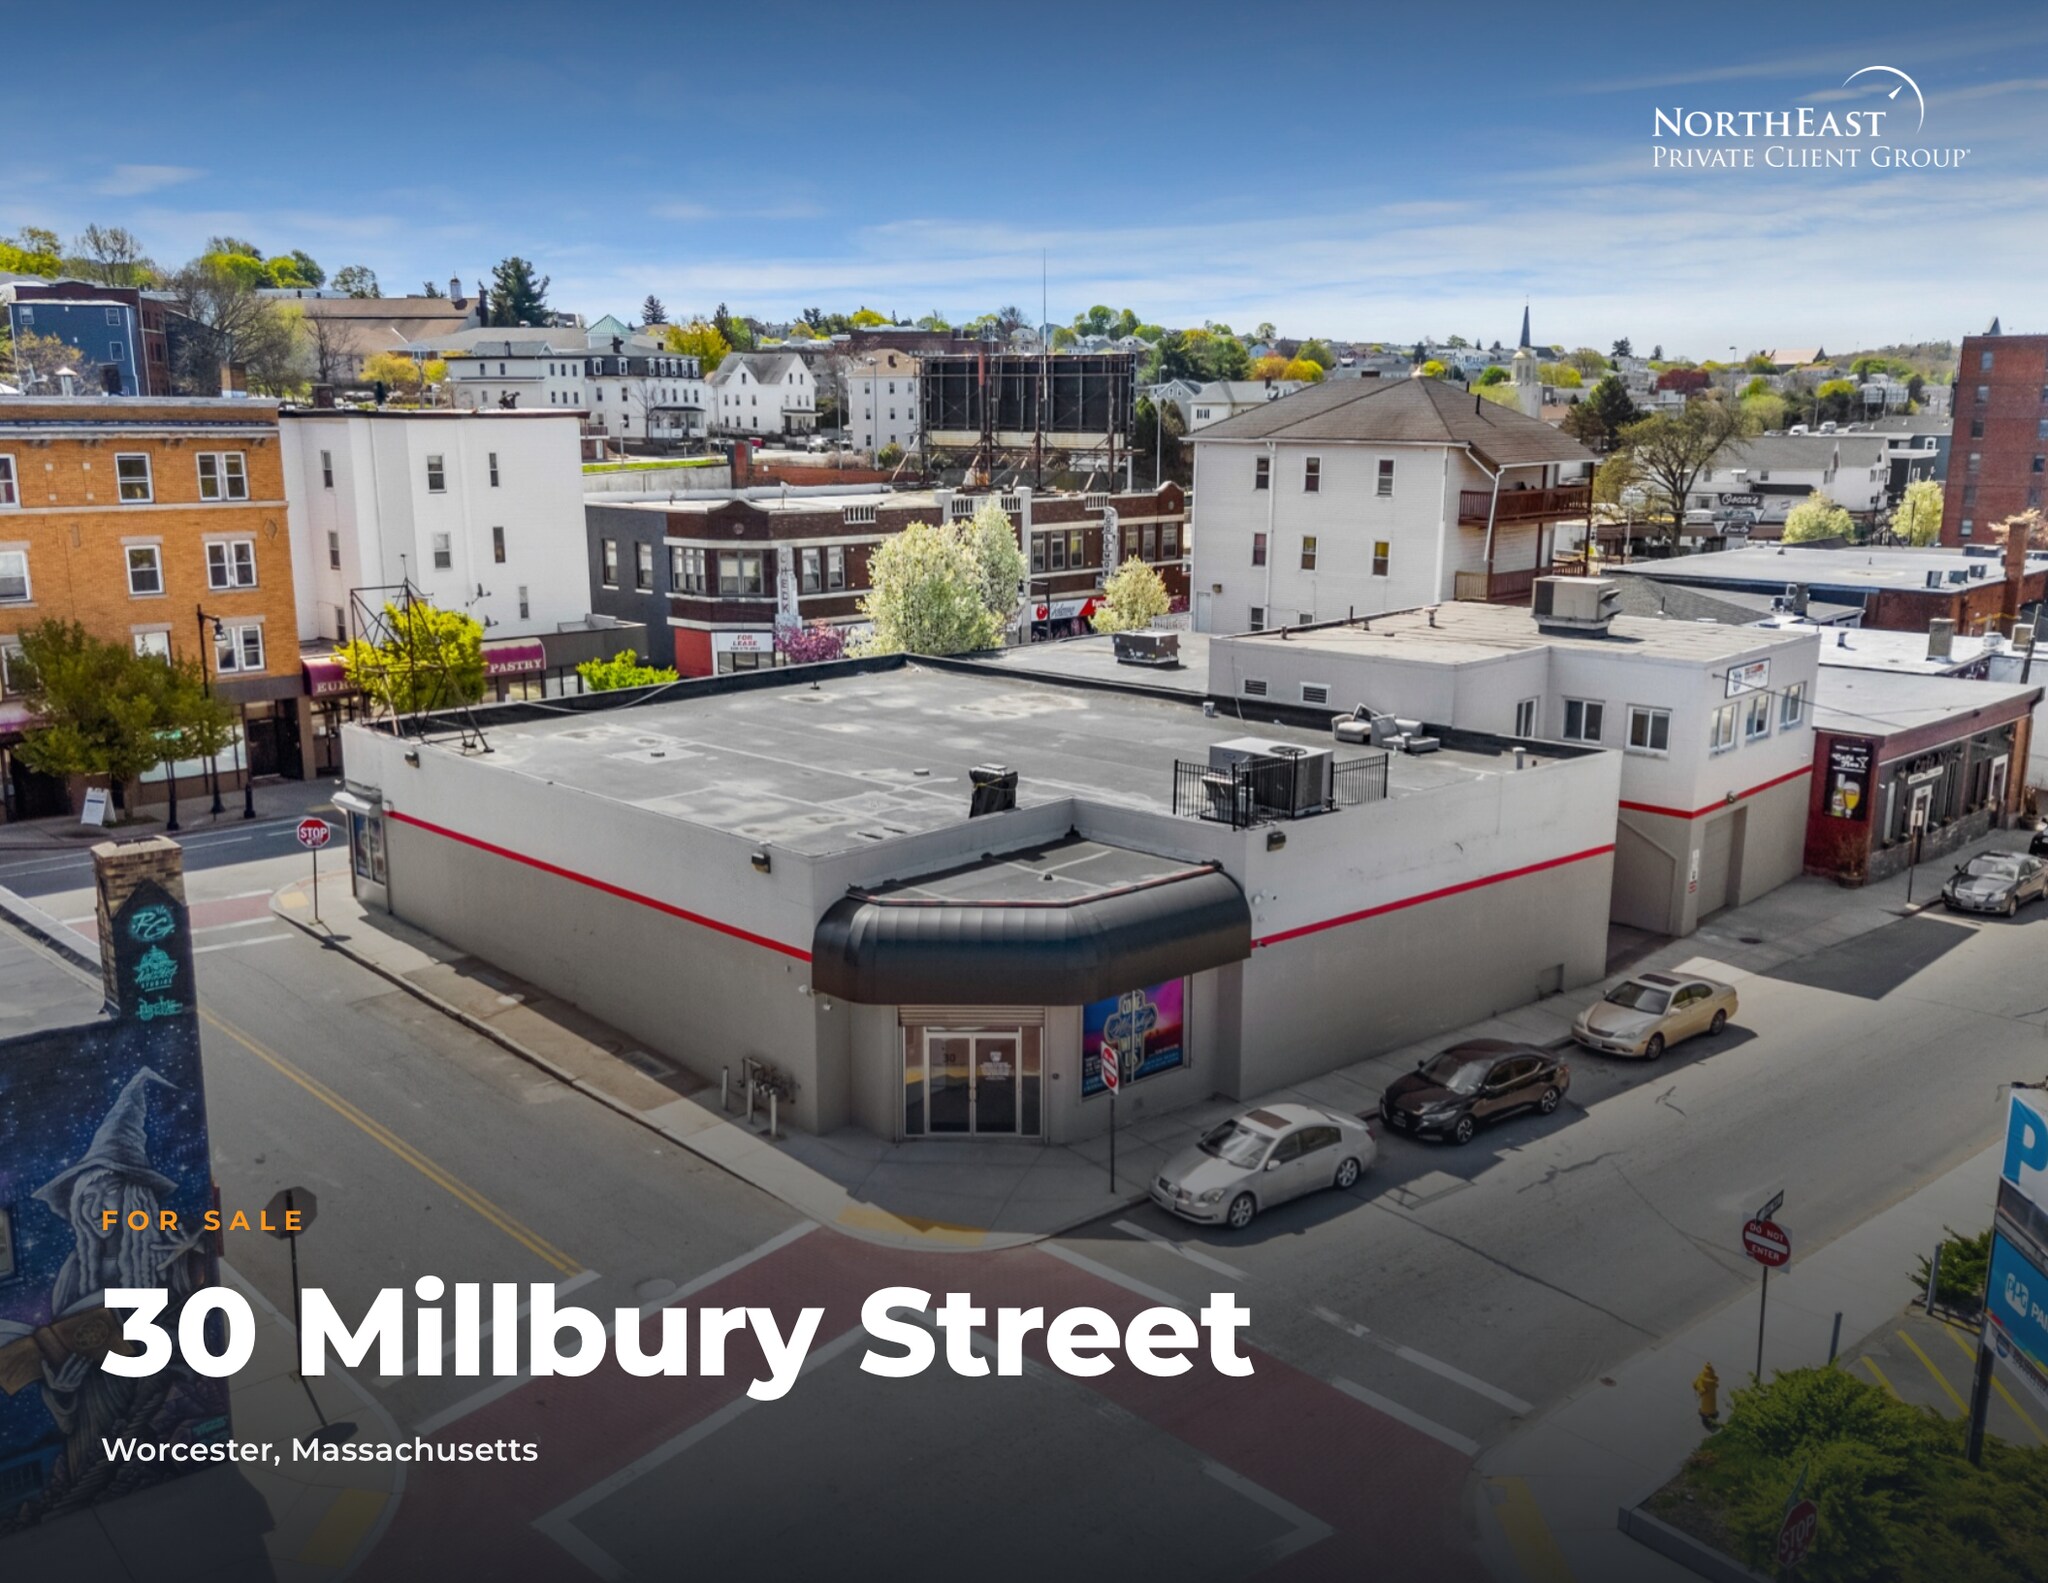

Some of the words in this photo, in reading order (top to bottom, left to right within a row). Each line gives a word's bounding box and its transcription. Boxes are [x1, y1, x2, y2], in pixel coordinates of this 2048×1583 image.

[490, 658, 542, 673] PASTRY
[300, 827, 328, 838] STOP
[1749, 1223, 1762, 1234] DO
[1766, 1230, 1784, 1242] NOT
[1751, 1244, 1780, 1261] ENTER
[1781, 1513, 1815, 1555] STOP
